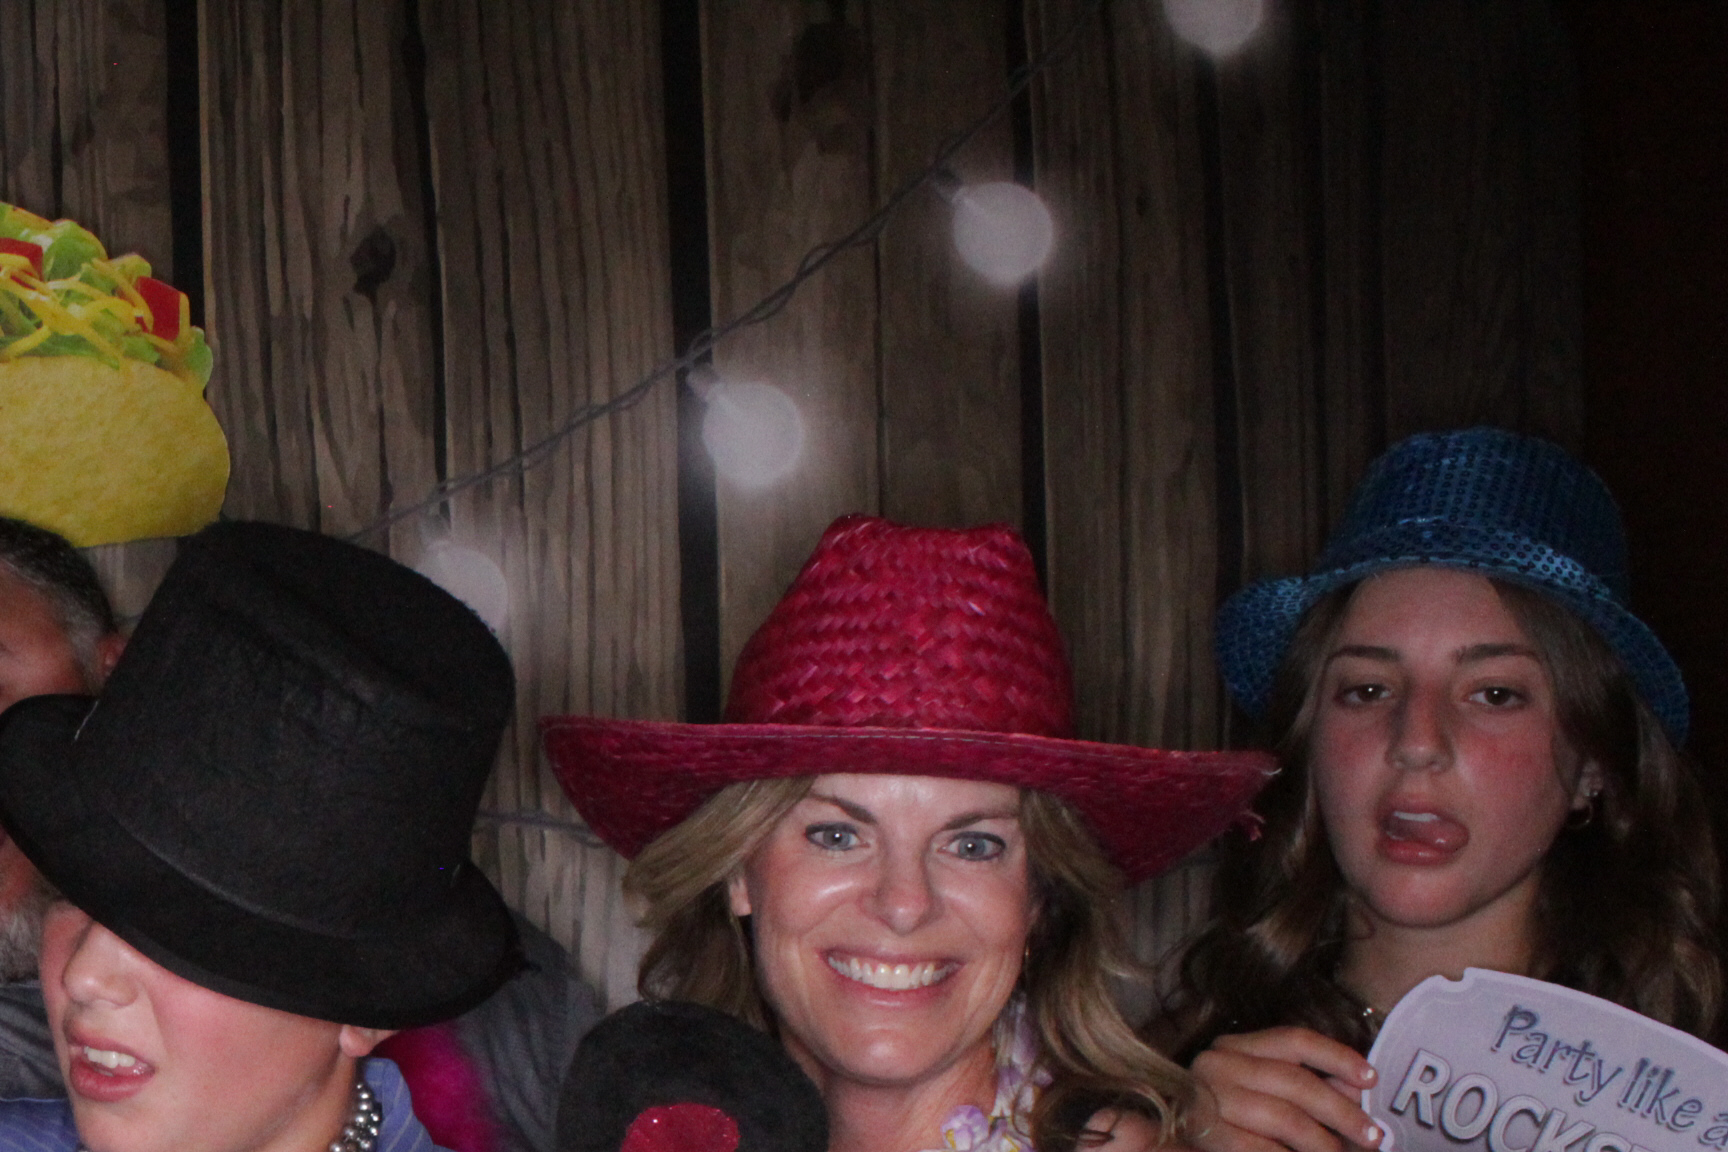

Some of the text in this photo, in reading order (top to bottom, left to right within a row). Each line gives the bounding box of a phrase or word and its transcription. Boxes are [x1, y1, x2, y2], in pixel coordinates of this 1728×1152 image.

[1490, 1003, 1728, 1151] Party like a
